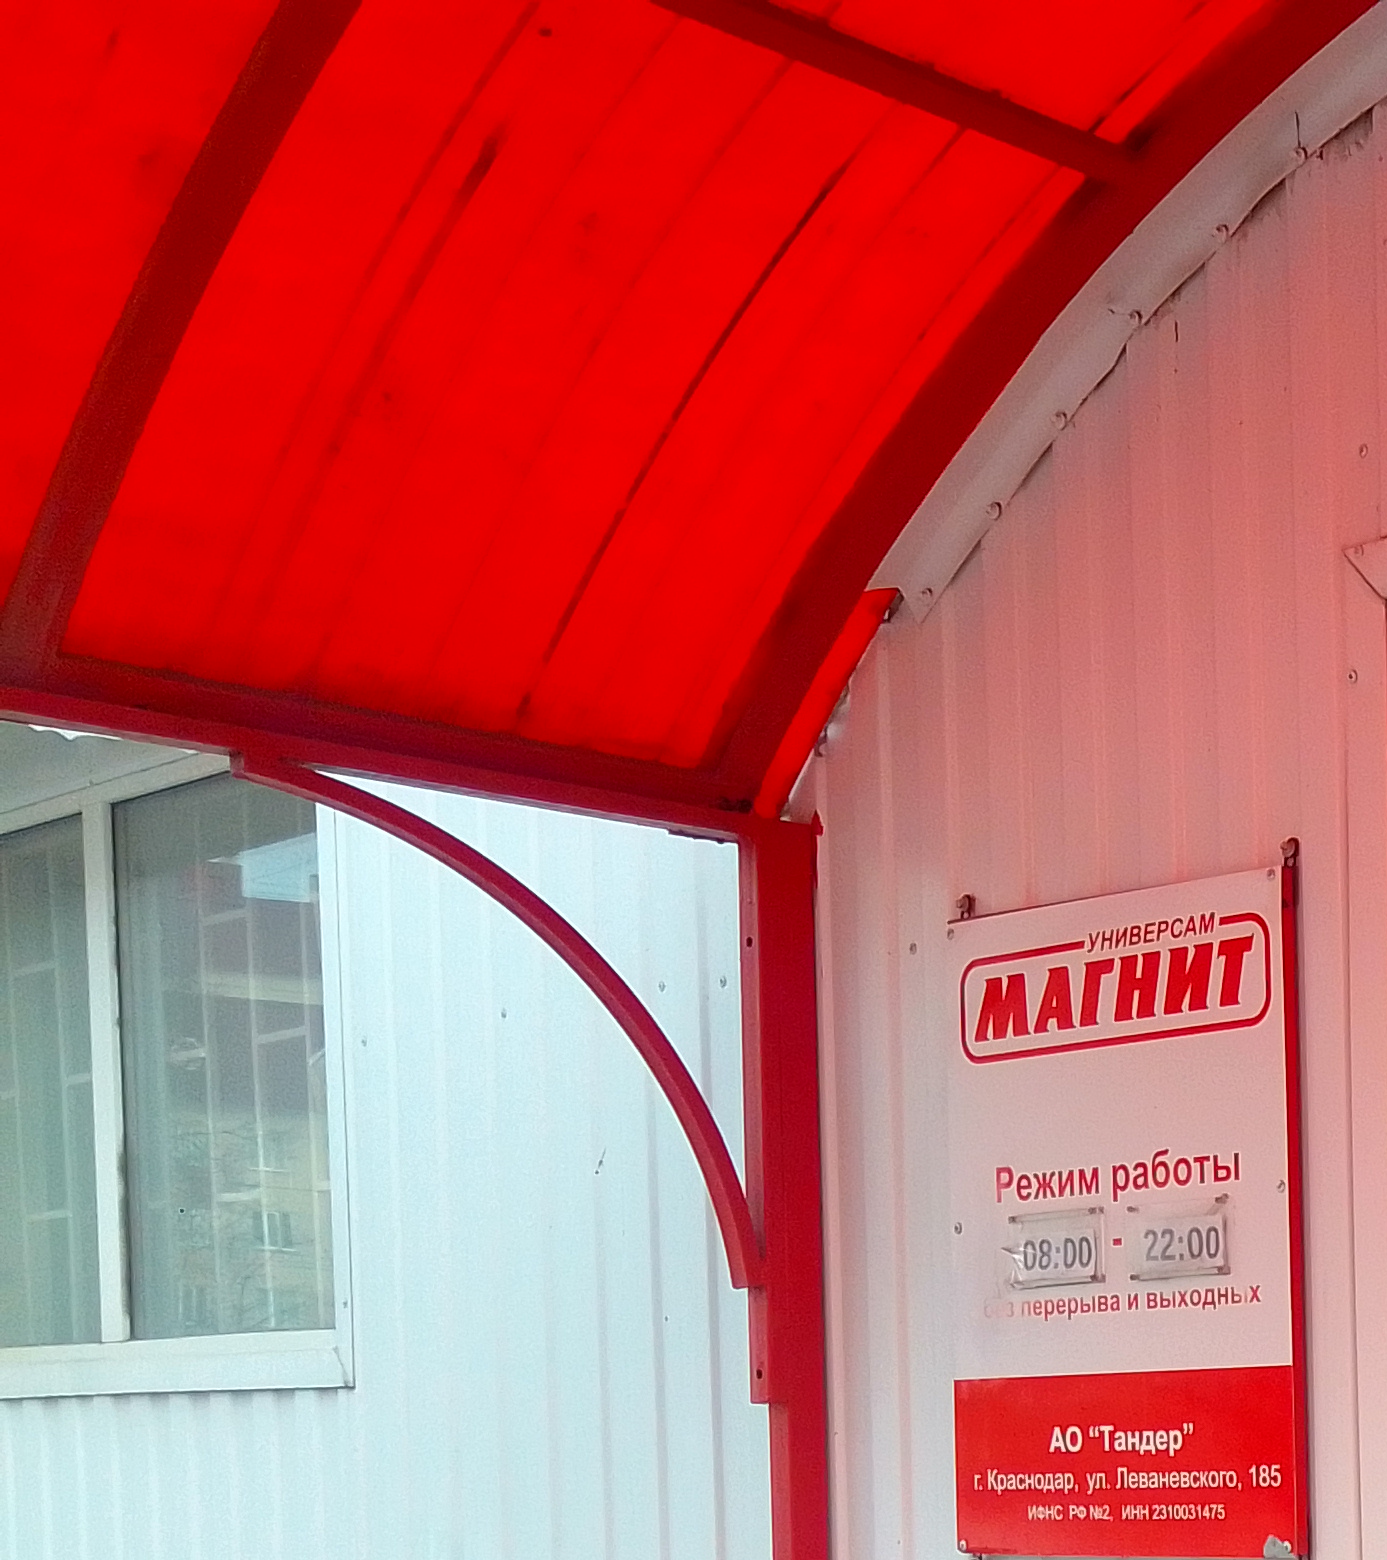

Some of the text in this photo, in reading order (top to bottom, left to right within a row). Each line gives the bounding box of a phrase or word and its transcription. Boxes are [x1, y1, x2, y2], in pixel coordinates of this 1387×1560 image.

[1086, 912, 1215, 953] УНИВЕРСАМ
[974, 933, 1255, 1043] МАГНИТ
[995, 1148, 1240, 1203] Режим работы
[1022, 1236, 1093, 1271] 08:00
[1143, 1225, 1221, 1262] 22:00
[1021, 1293, 1121, 1322] перерыва
[1127, 1292, 1139, 1311] и
[1146, 1284, 1262, 1313] выходных
[1049, 1426, 1083, 1453] АО
[973, 1464, 1282, 1495] г. Краснодар, ул. Леваневского, 185
[1027, 1505, 1063, 1521] ИФНС
[1069, 1505, 1087, 1521] РФ
[1121, 1504, 1149, 1521] ИНН
[1152, 1503, 1226, 1521] 2310031475
